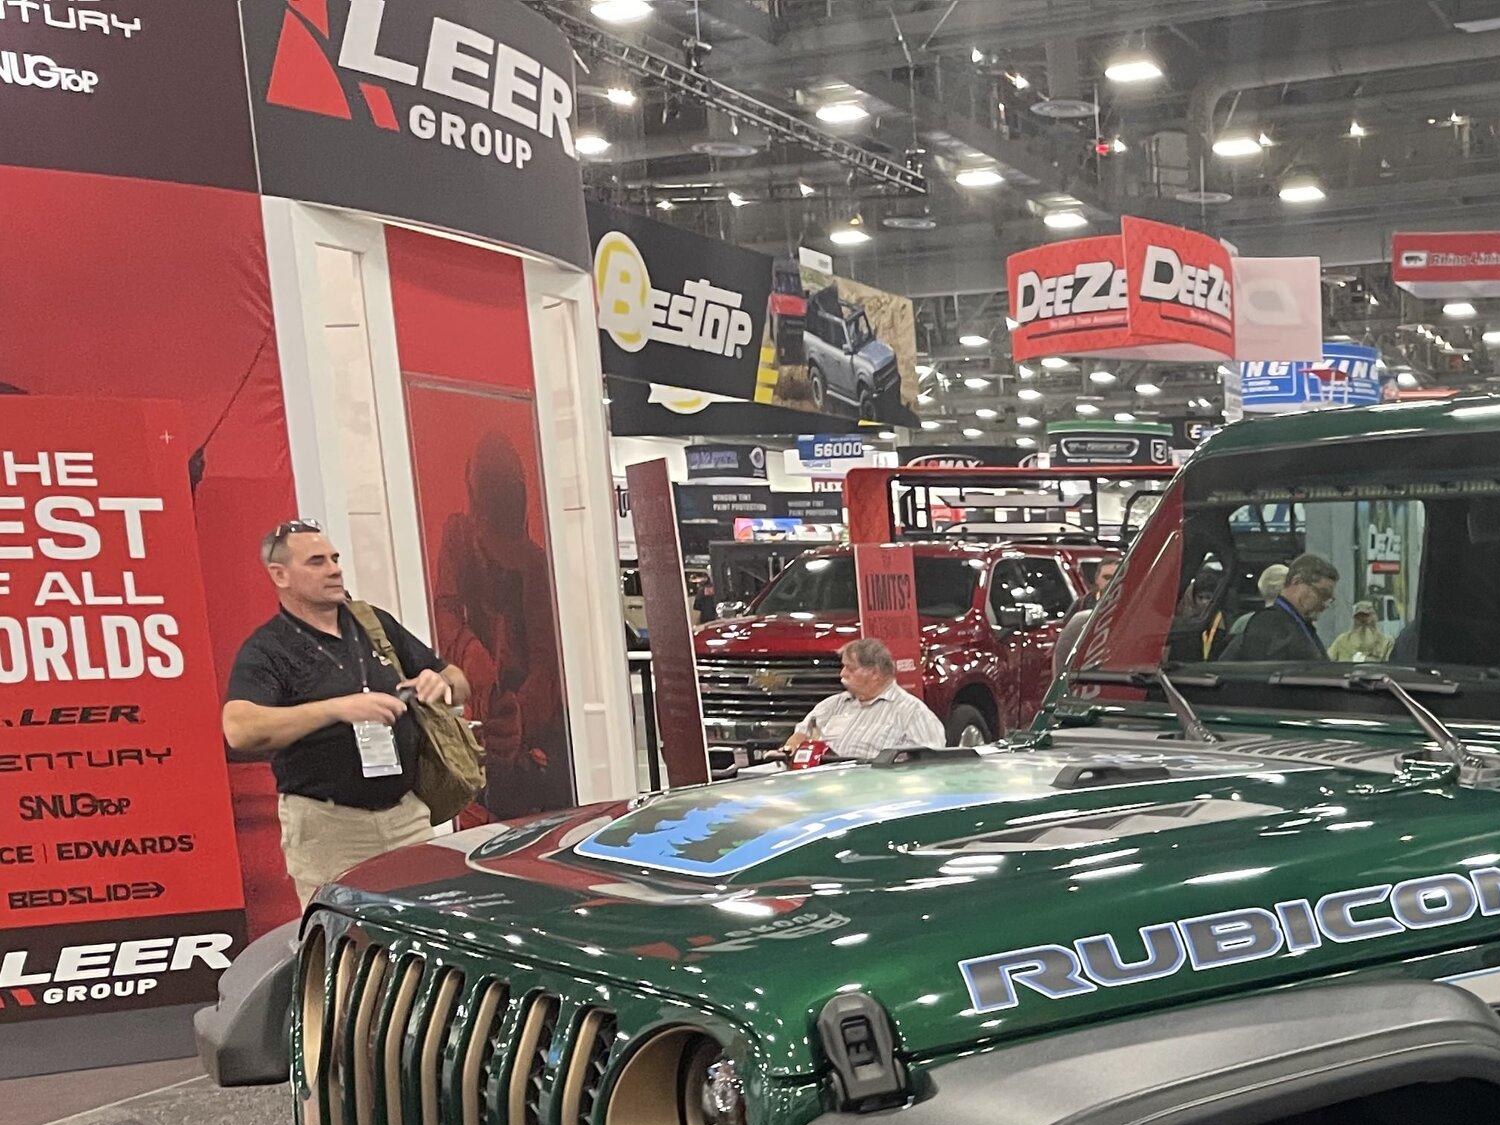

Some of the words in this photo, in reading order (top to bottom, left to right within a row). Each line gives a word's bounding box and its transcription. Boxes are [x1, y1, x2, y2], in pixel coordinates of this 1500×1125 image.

[0, 0, 141, 38] TURY
[338, 0, 578, 160] LEER
[409, 105, 532, 169] GROUP
[34, 571, 165, 606] ALL
[20, 705, 141, 727] LEER
[56, 834, 195, 861] EDWARDS
[0, 933, 234, 988] LEER
[43, 978, 158, 1005] GROUP
